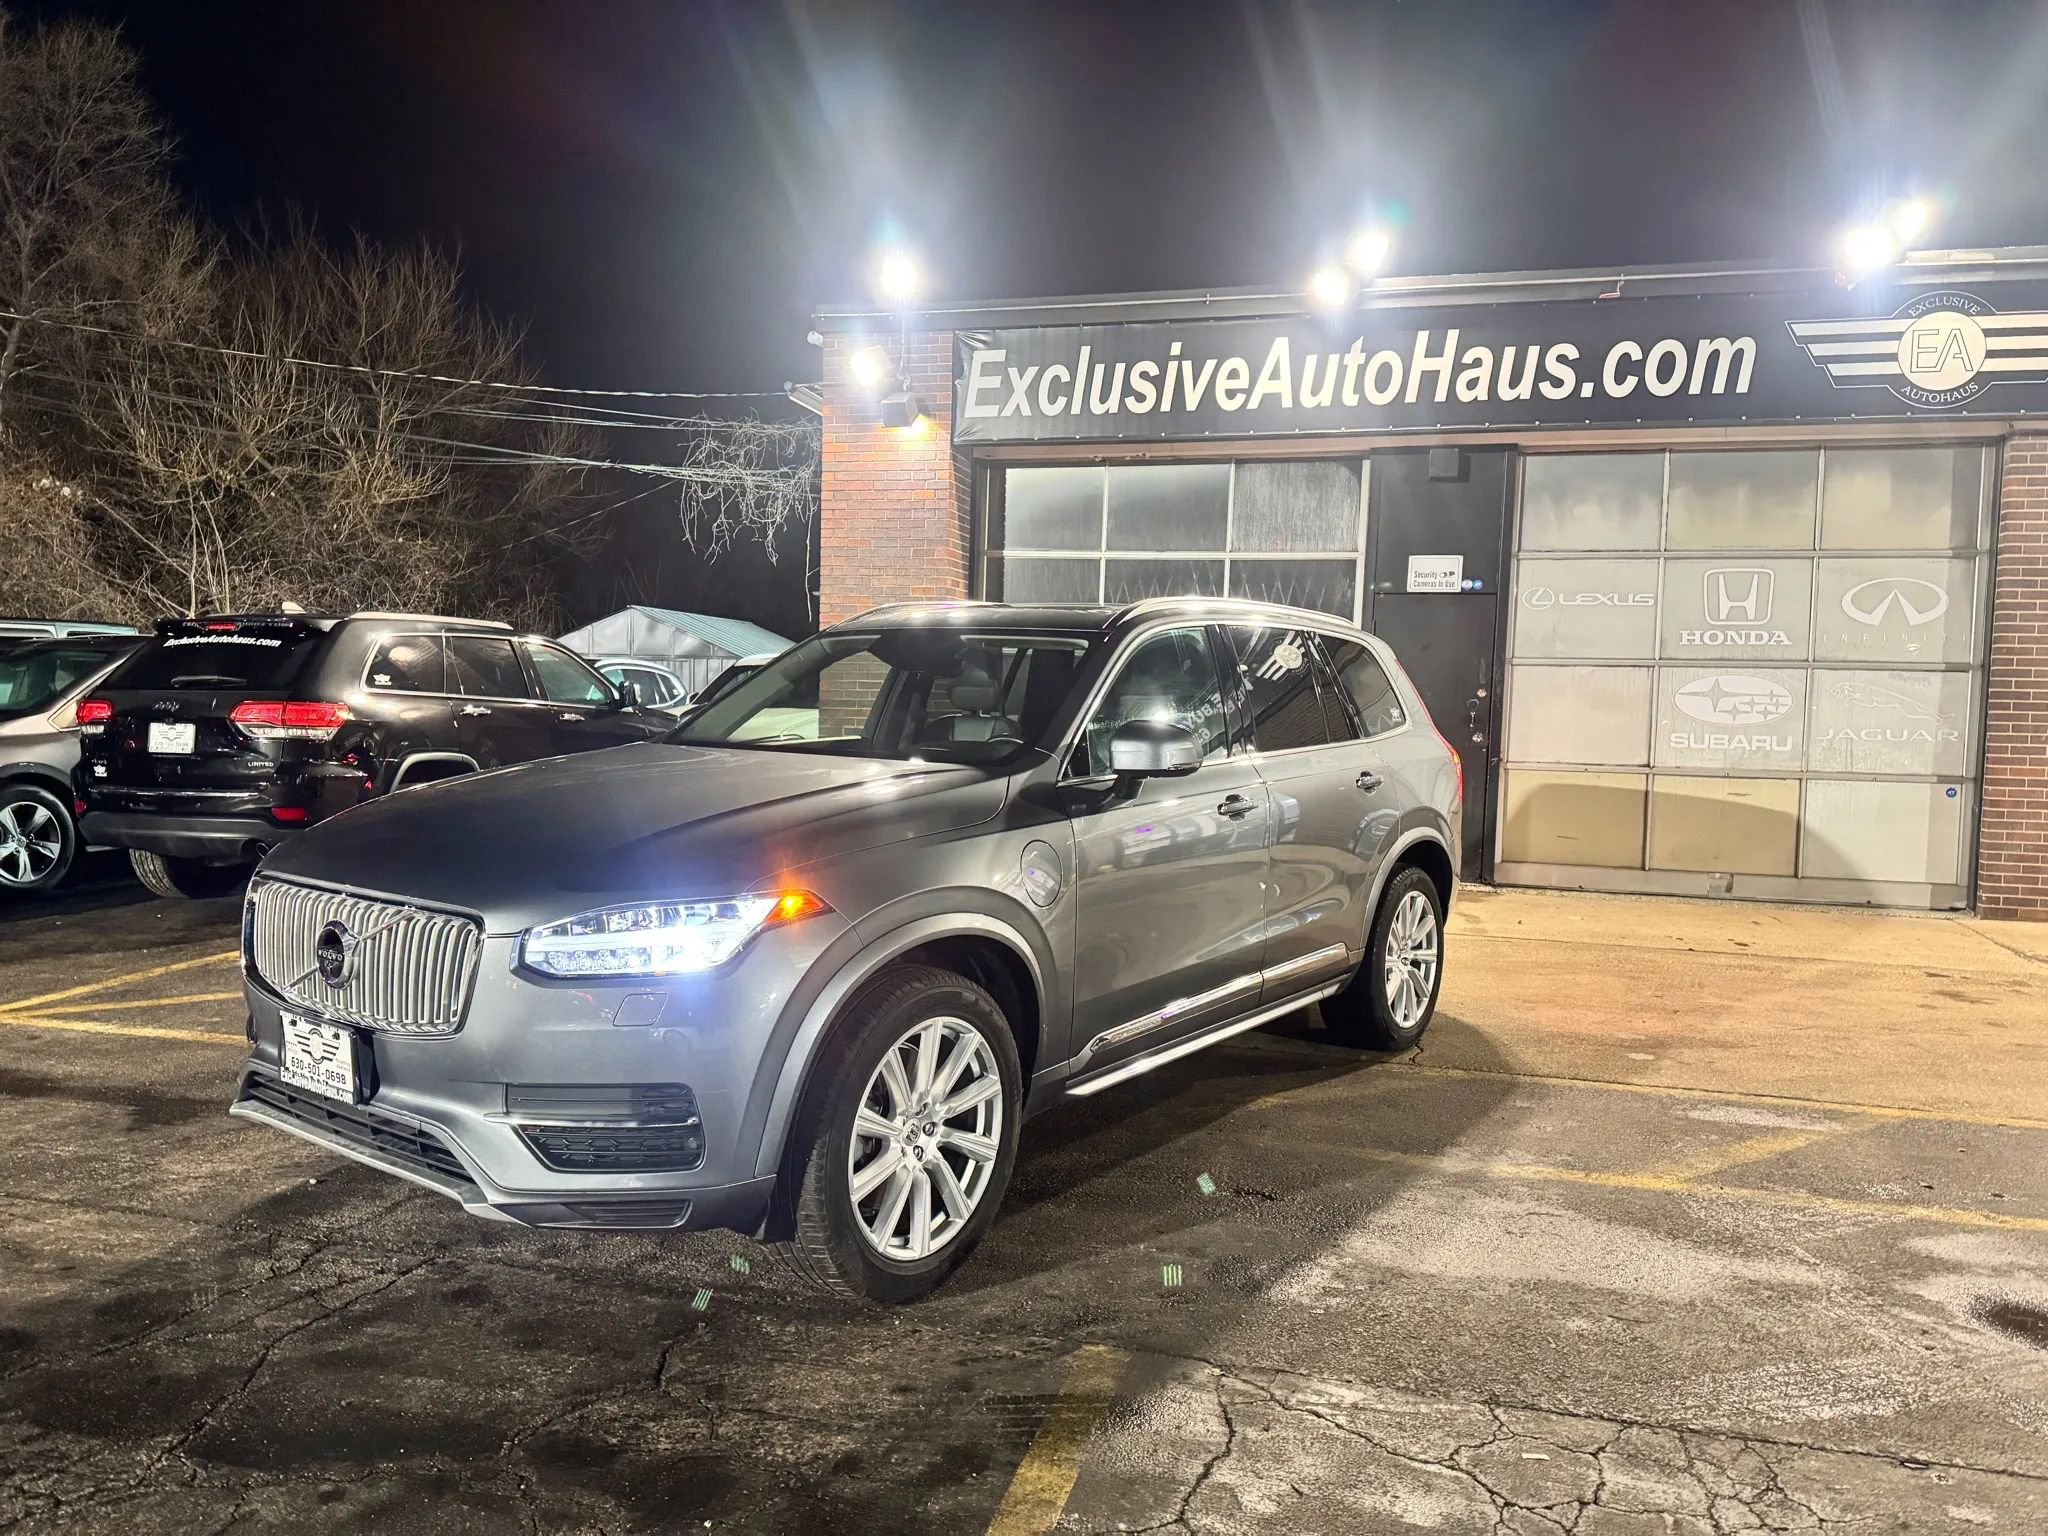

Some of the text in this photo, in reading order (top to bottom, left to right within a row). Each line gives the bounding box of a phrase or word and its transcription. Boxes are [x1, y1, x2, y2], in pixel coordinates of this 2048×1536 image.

[1908, 296, 1981, 318] EXCLUSIVE
[964, 328, 1757, 418] ExclusiveAutoHaus.com
[1901, 381, 1979, 403] AUTOHAUS
[1413, 570, 1438, 580] Security
[1413, 579, 1437, 588] Cameras
[1558, 592, 1655, 606] LEXUS
[1678, 630, 1793, 646] HONDA
[1669, 733, 1793, 752] SUBARU
[1814, 728, 1960, 742] JAGUAR
[291, 1056, 347, 1085] 630-501-0698
